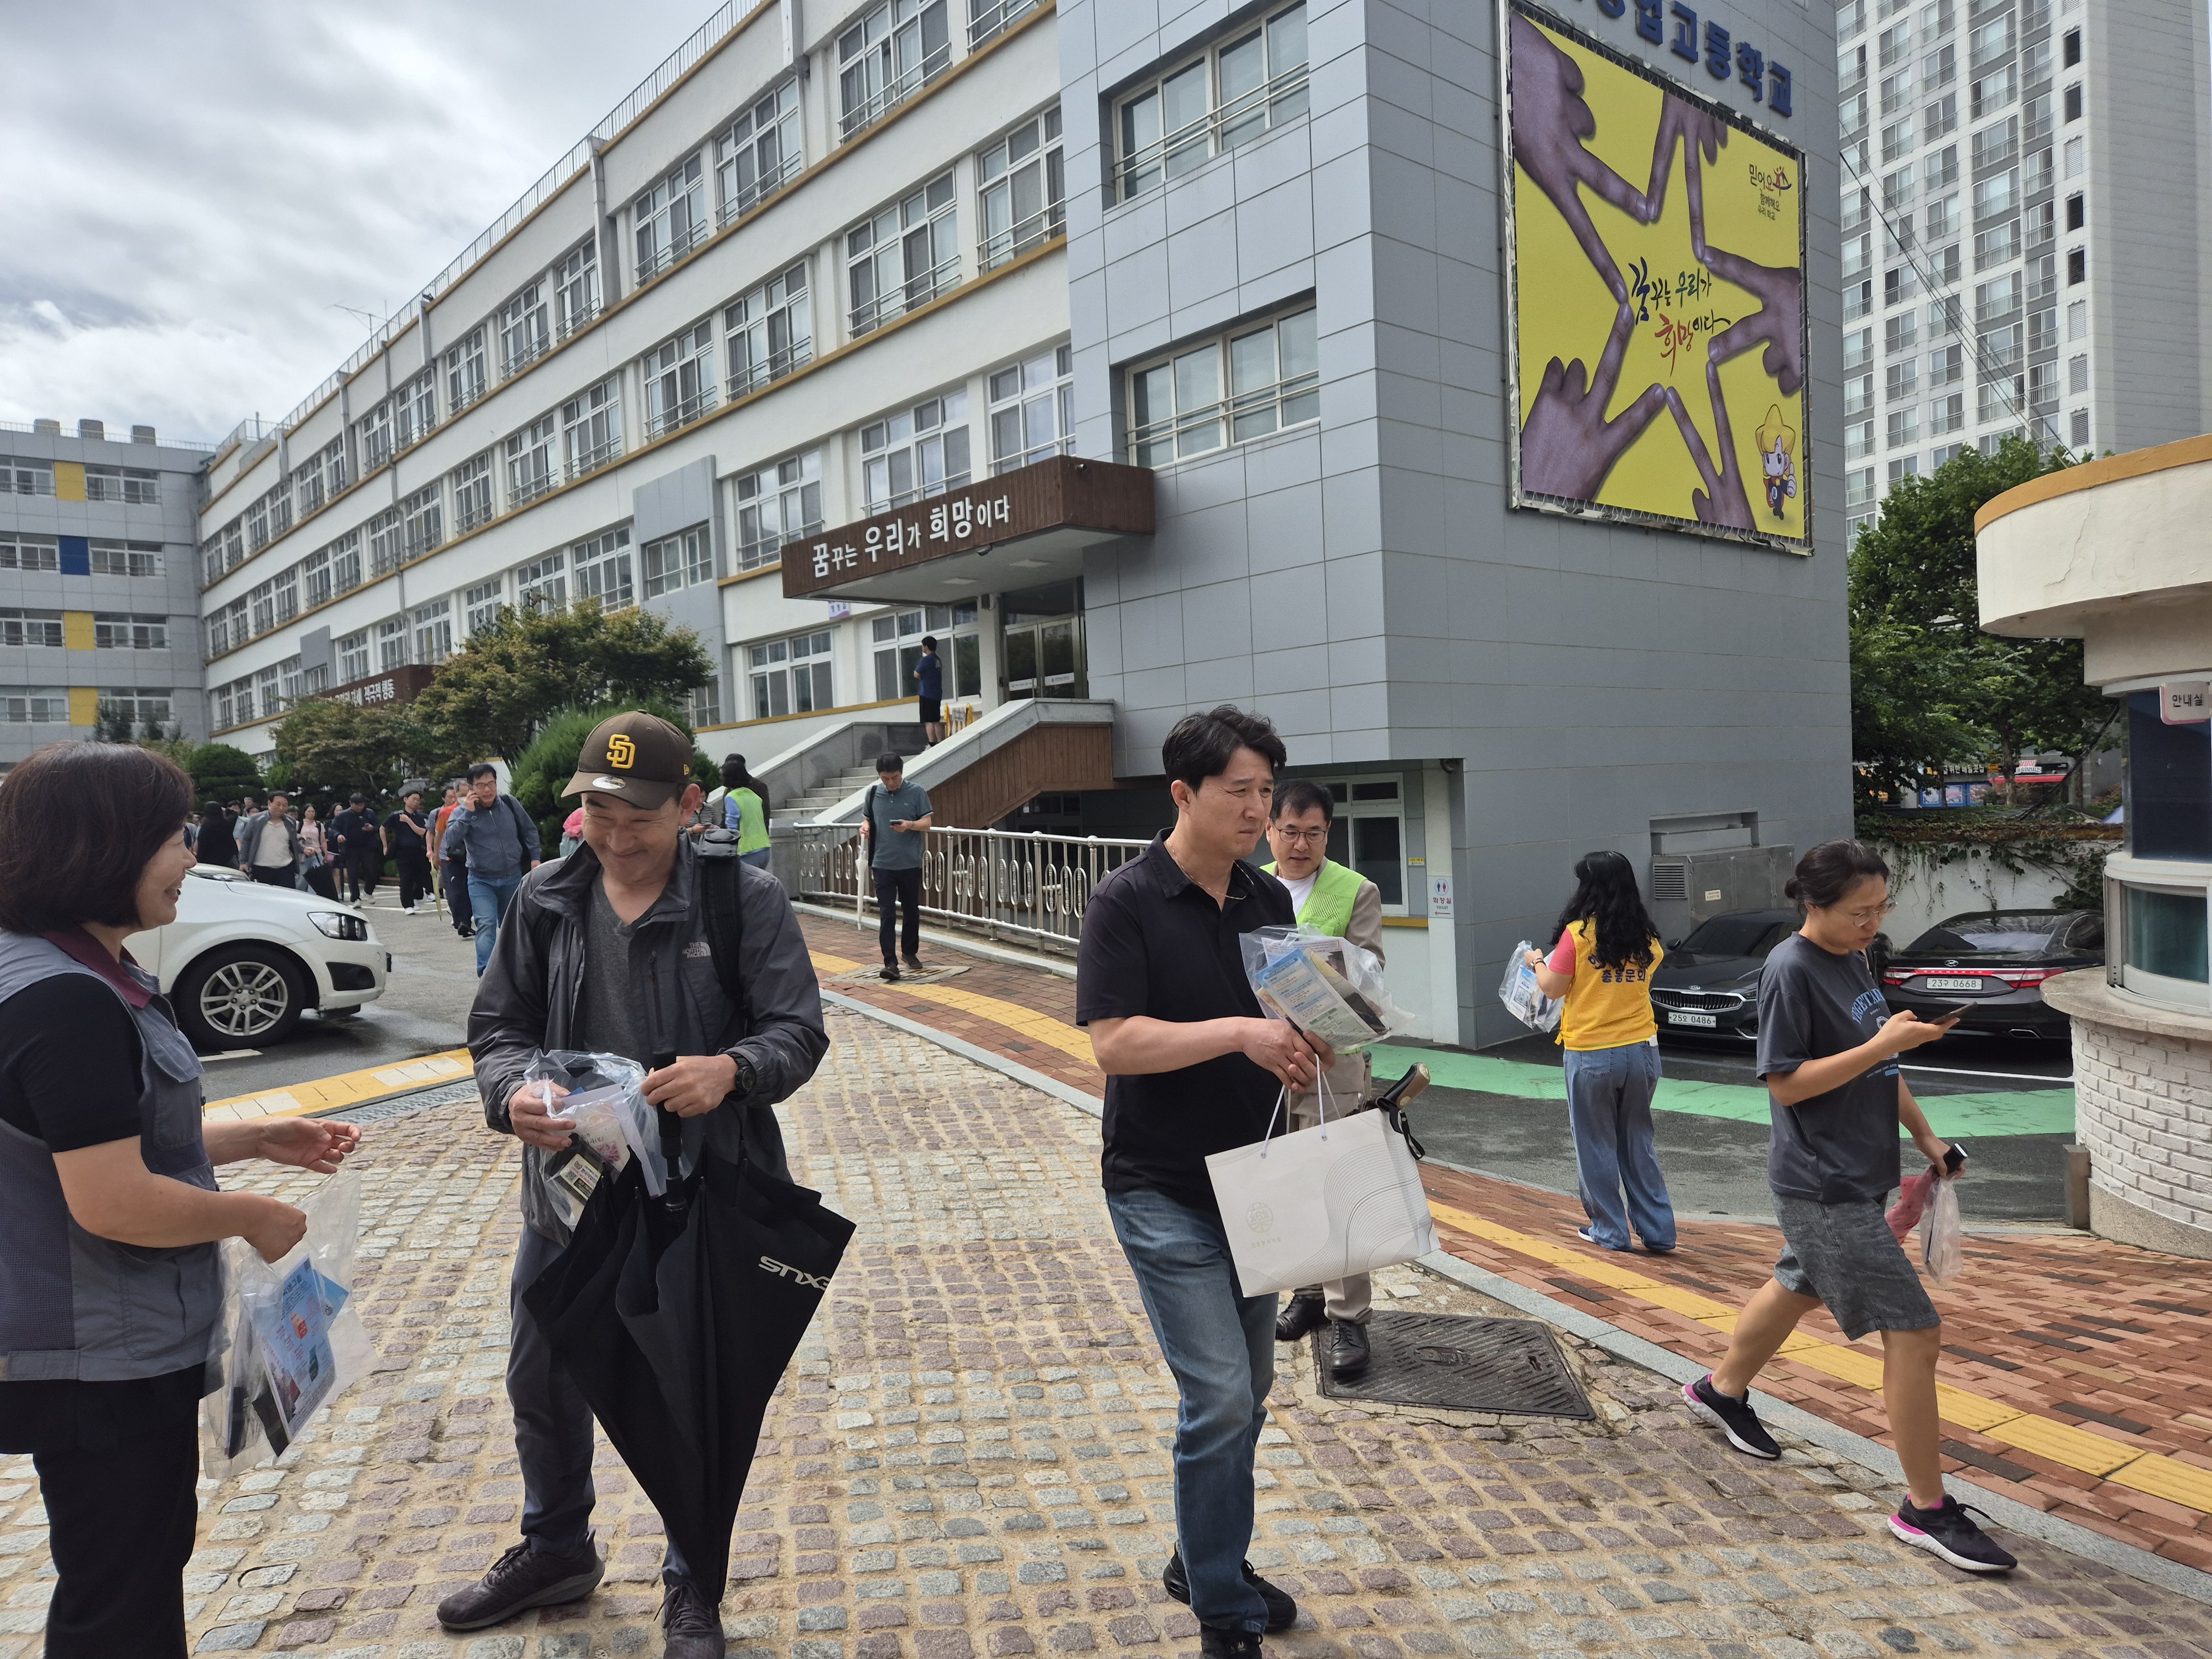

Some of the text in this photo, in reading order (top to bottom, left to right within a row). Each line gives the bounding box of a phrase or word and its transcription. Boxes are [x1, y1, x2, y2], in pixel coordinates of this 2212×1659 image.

[1598, 0, 1792, 117] 업고등학교
[1749, 163, 1774, 191] 믿어요
[1628, 256, 1712, 325] 꿈꾸는 우리가
[1655, 309, 1731, 377] 희망이다
[812, 494, 1011, 578] 꿈꾸는 우리가 희망이다
[364, 681, 383, 704] 적극적
[382, 678, 395, 701] 행동
[2172, 693, 2203, 707] 안내실
[607, 734, 636, 769] SD
[1949, 764, 1960, 774] 위한
[682, 947, 701, 955] NORTH
[1601, 969, 1646, 983] 총동문회
[1953, 979, 1977, 988] 0668
[1673, 1014, 1712, 1025] 25오 0486
